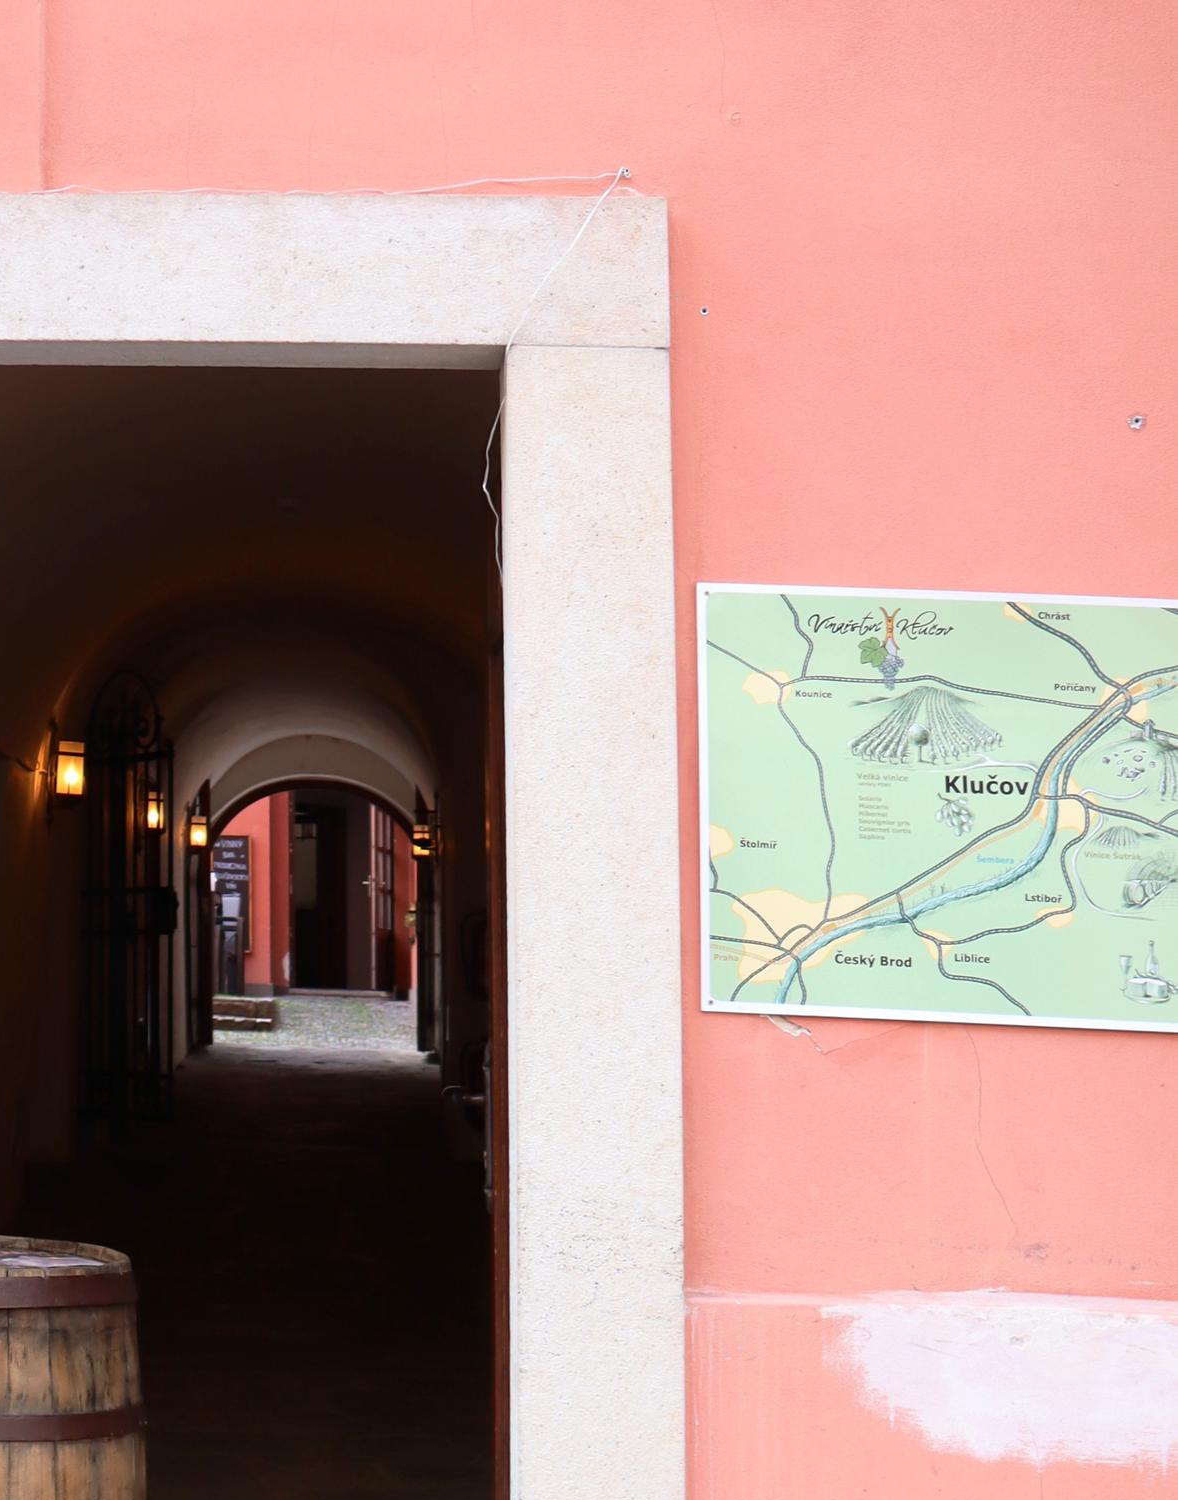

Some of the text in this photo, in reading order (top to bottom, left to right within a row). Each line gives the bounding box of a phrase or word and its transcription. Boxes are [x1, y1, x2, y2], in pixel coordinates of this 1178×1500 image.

[1038, 611, 1071, 621] Chrást
[896, 610, 954, 640] Klučov
[1054, 682, 1097, 694] Poříčany
[795, 690, 833, 699] Kounice
[944, 774, 1029, 795] Klučov
[1025, 893, 1062, 904] Lstiboř
[713, 953, 739, 962] Praha
[834, 950, 912, 968] Český Brod
[954, 953, 990, 964] Liblice
